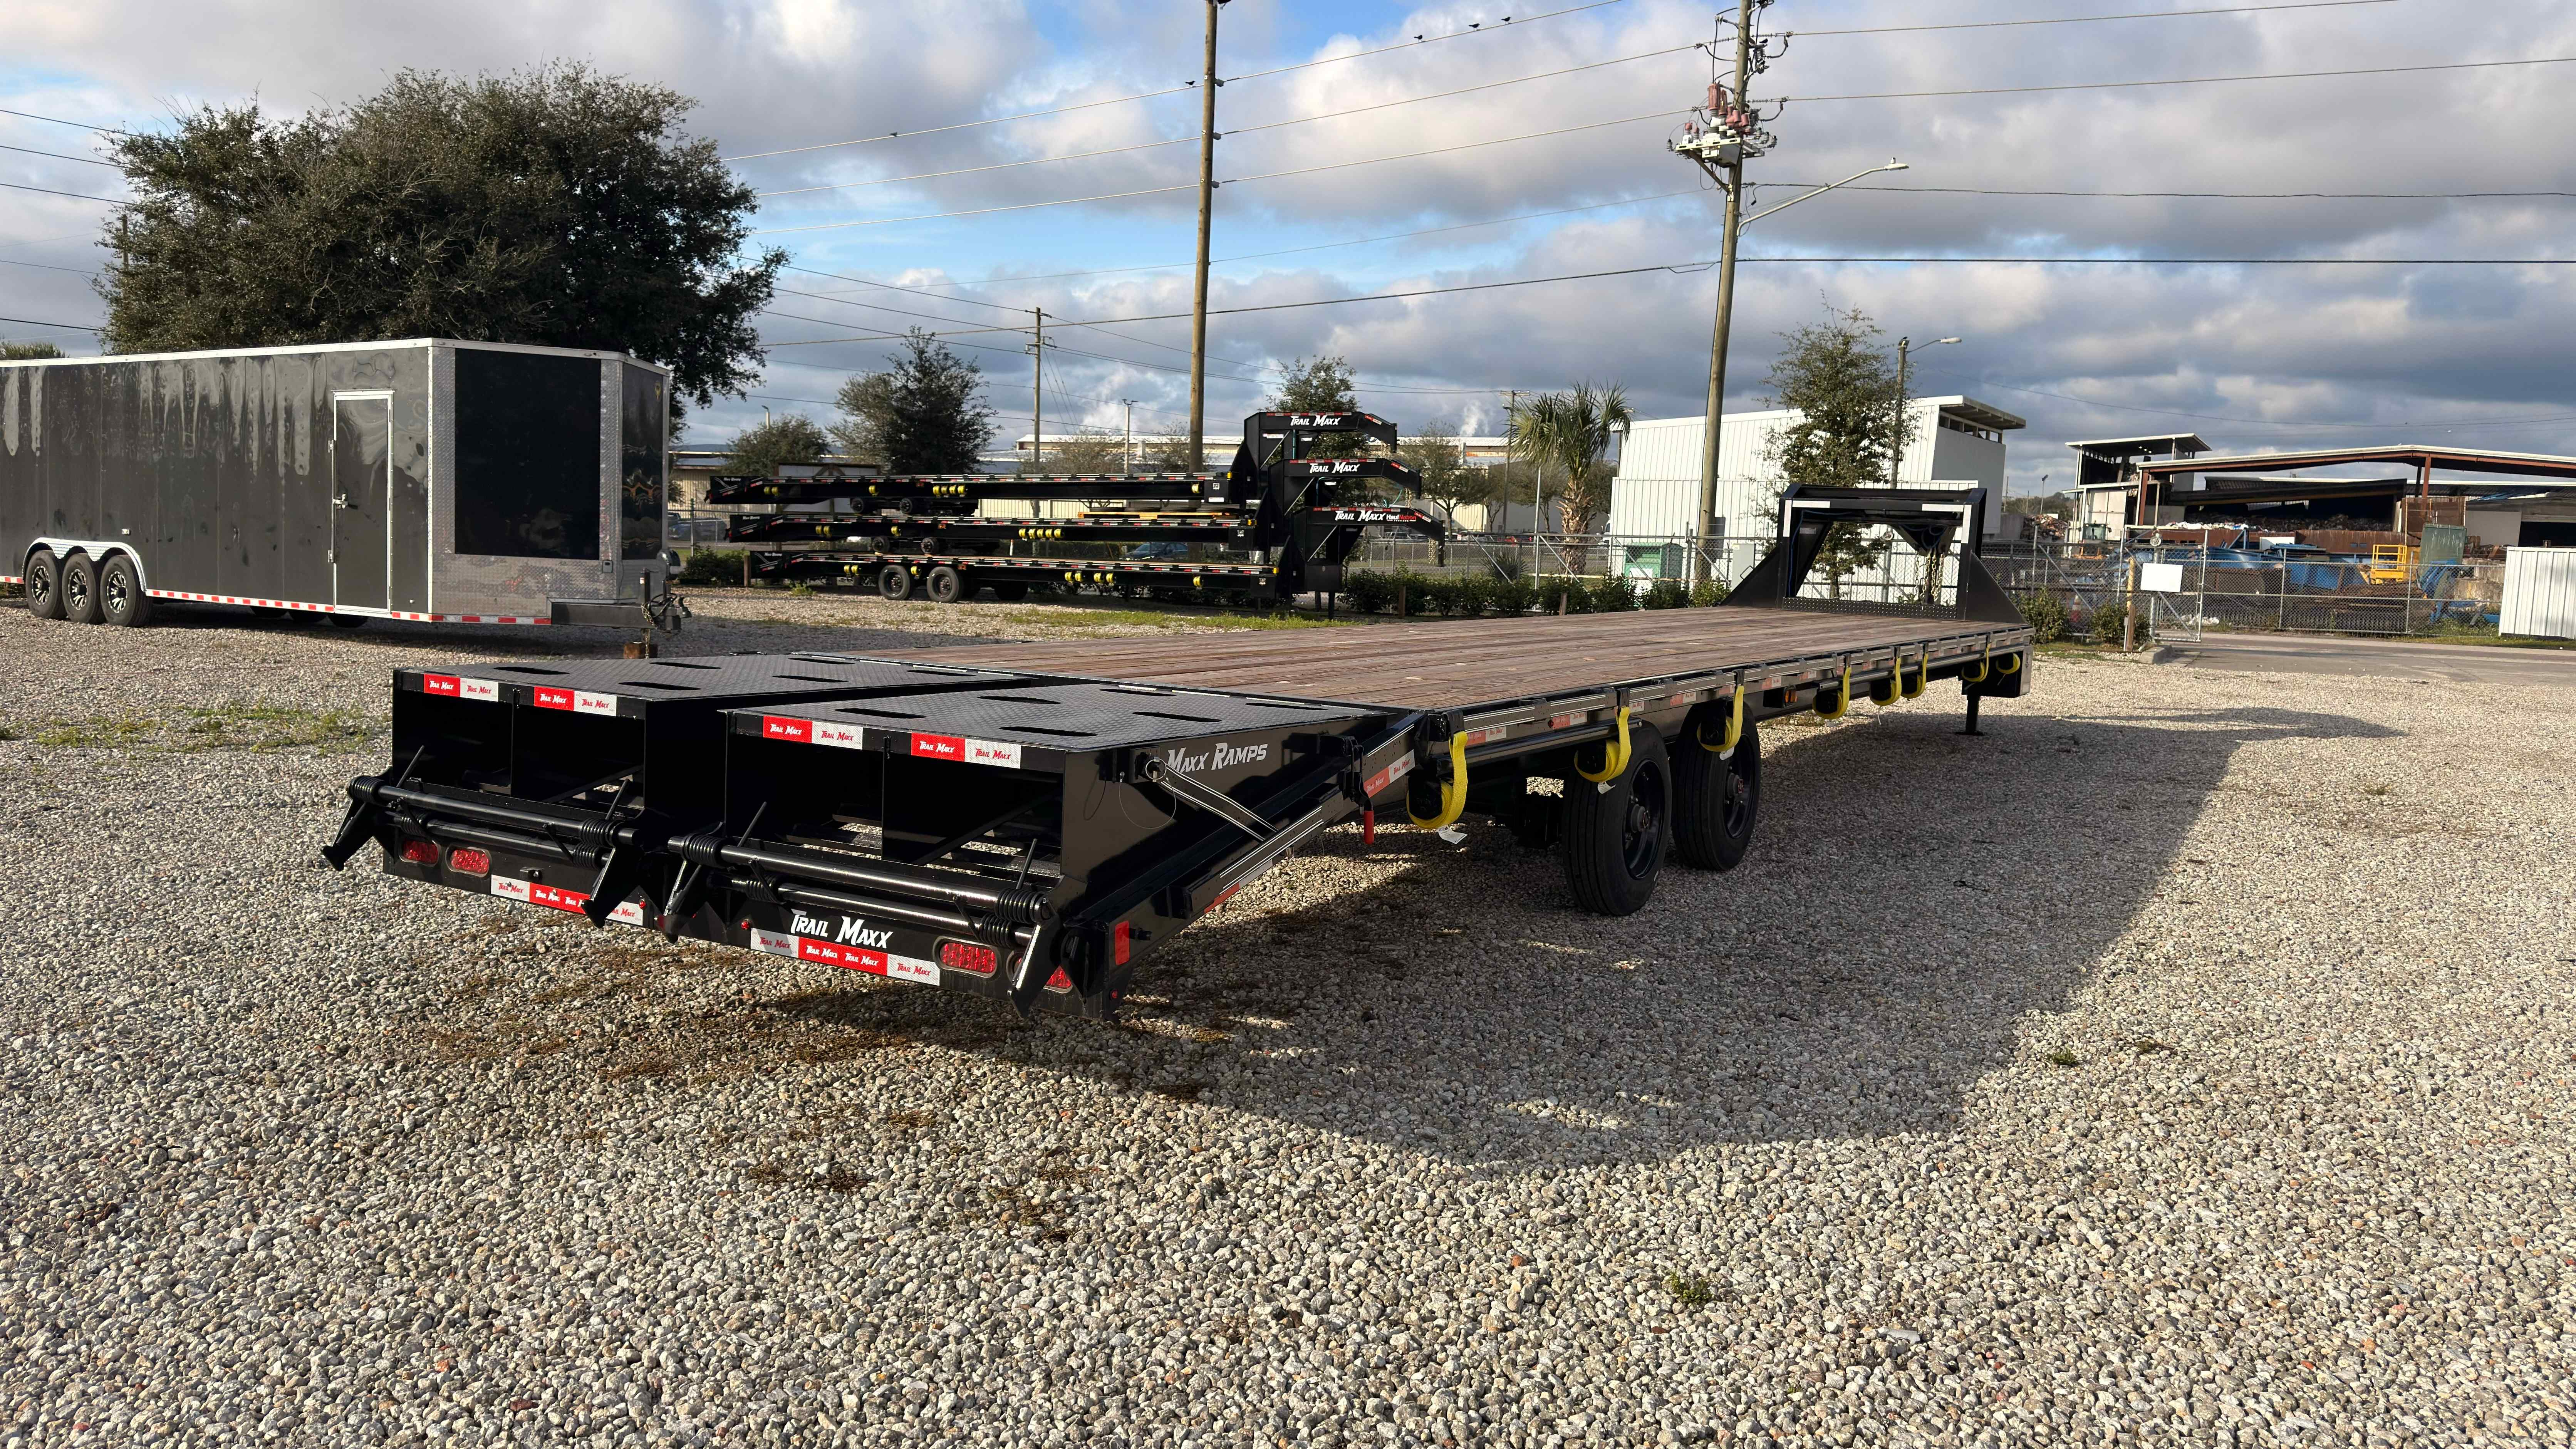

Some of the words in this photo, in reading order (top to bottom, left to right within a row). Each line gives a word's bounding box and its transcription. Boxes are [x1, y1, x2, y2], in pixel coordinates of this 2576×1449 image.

[1290, 416, 1310, 426] TRAIL
[1313, 415, 1341, 426] MAXX
[1310, 463, 1329, 473] TRAIL
[1332, 462, 1360, 473] MAXX
[1335, 510, 1355, 521] TRAIL
[1357, 510, 1387, 521] MAXX
[1167, 747, 1209, 773] MAXX
[1211, 742, 1268, 770] RAMPS
[790, 908, 829, 937] TRAIL
[835, 915, 893, 949] MAXX
